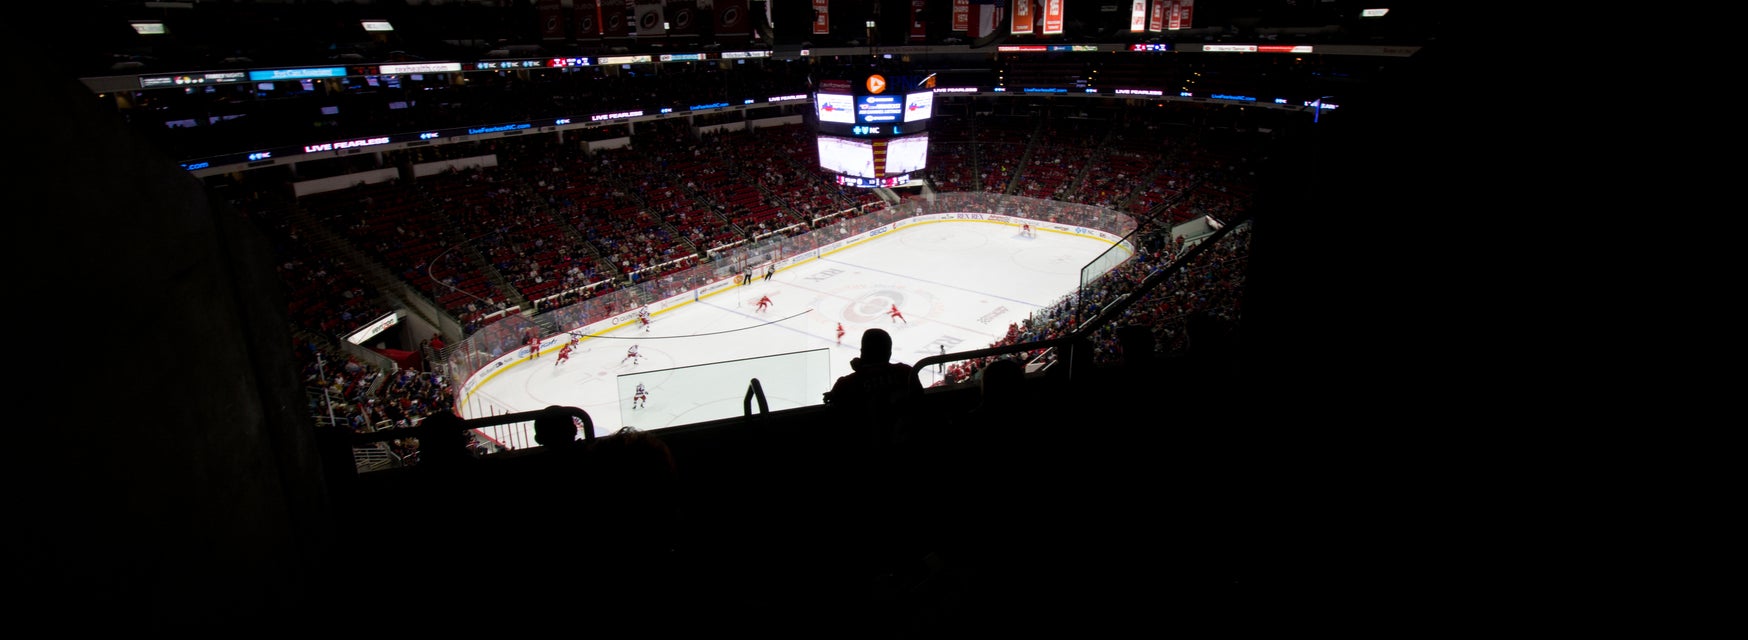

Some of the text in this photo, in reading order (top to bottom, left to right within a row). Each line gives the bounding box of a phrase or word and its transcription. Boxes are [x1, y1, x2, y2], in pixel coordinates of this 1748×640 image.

[591, 110, 644, 122] LIVE FEARLESS
[869, 126, 880, 134] NC
[305, 137, 391, 153] LIVE FEARLESS
[869, 226, 888, 237] GEICO
